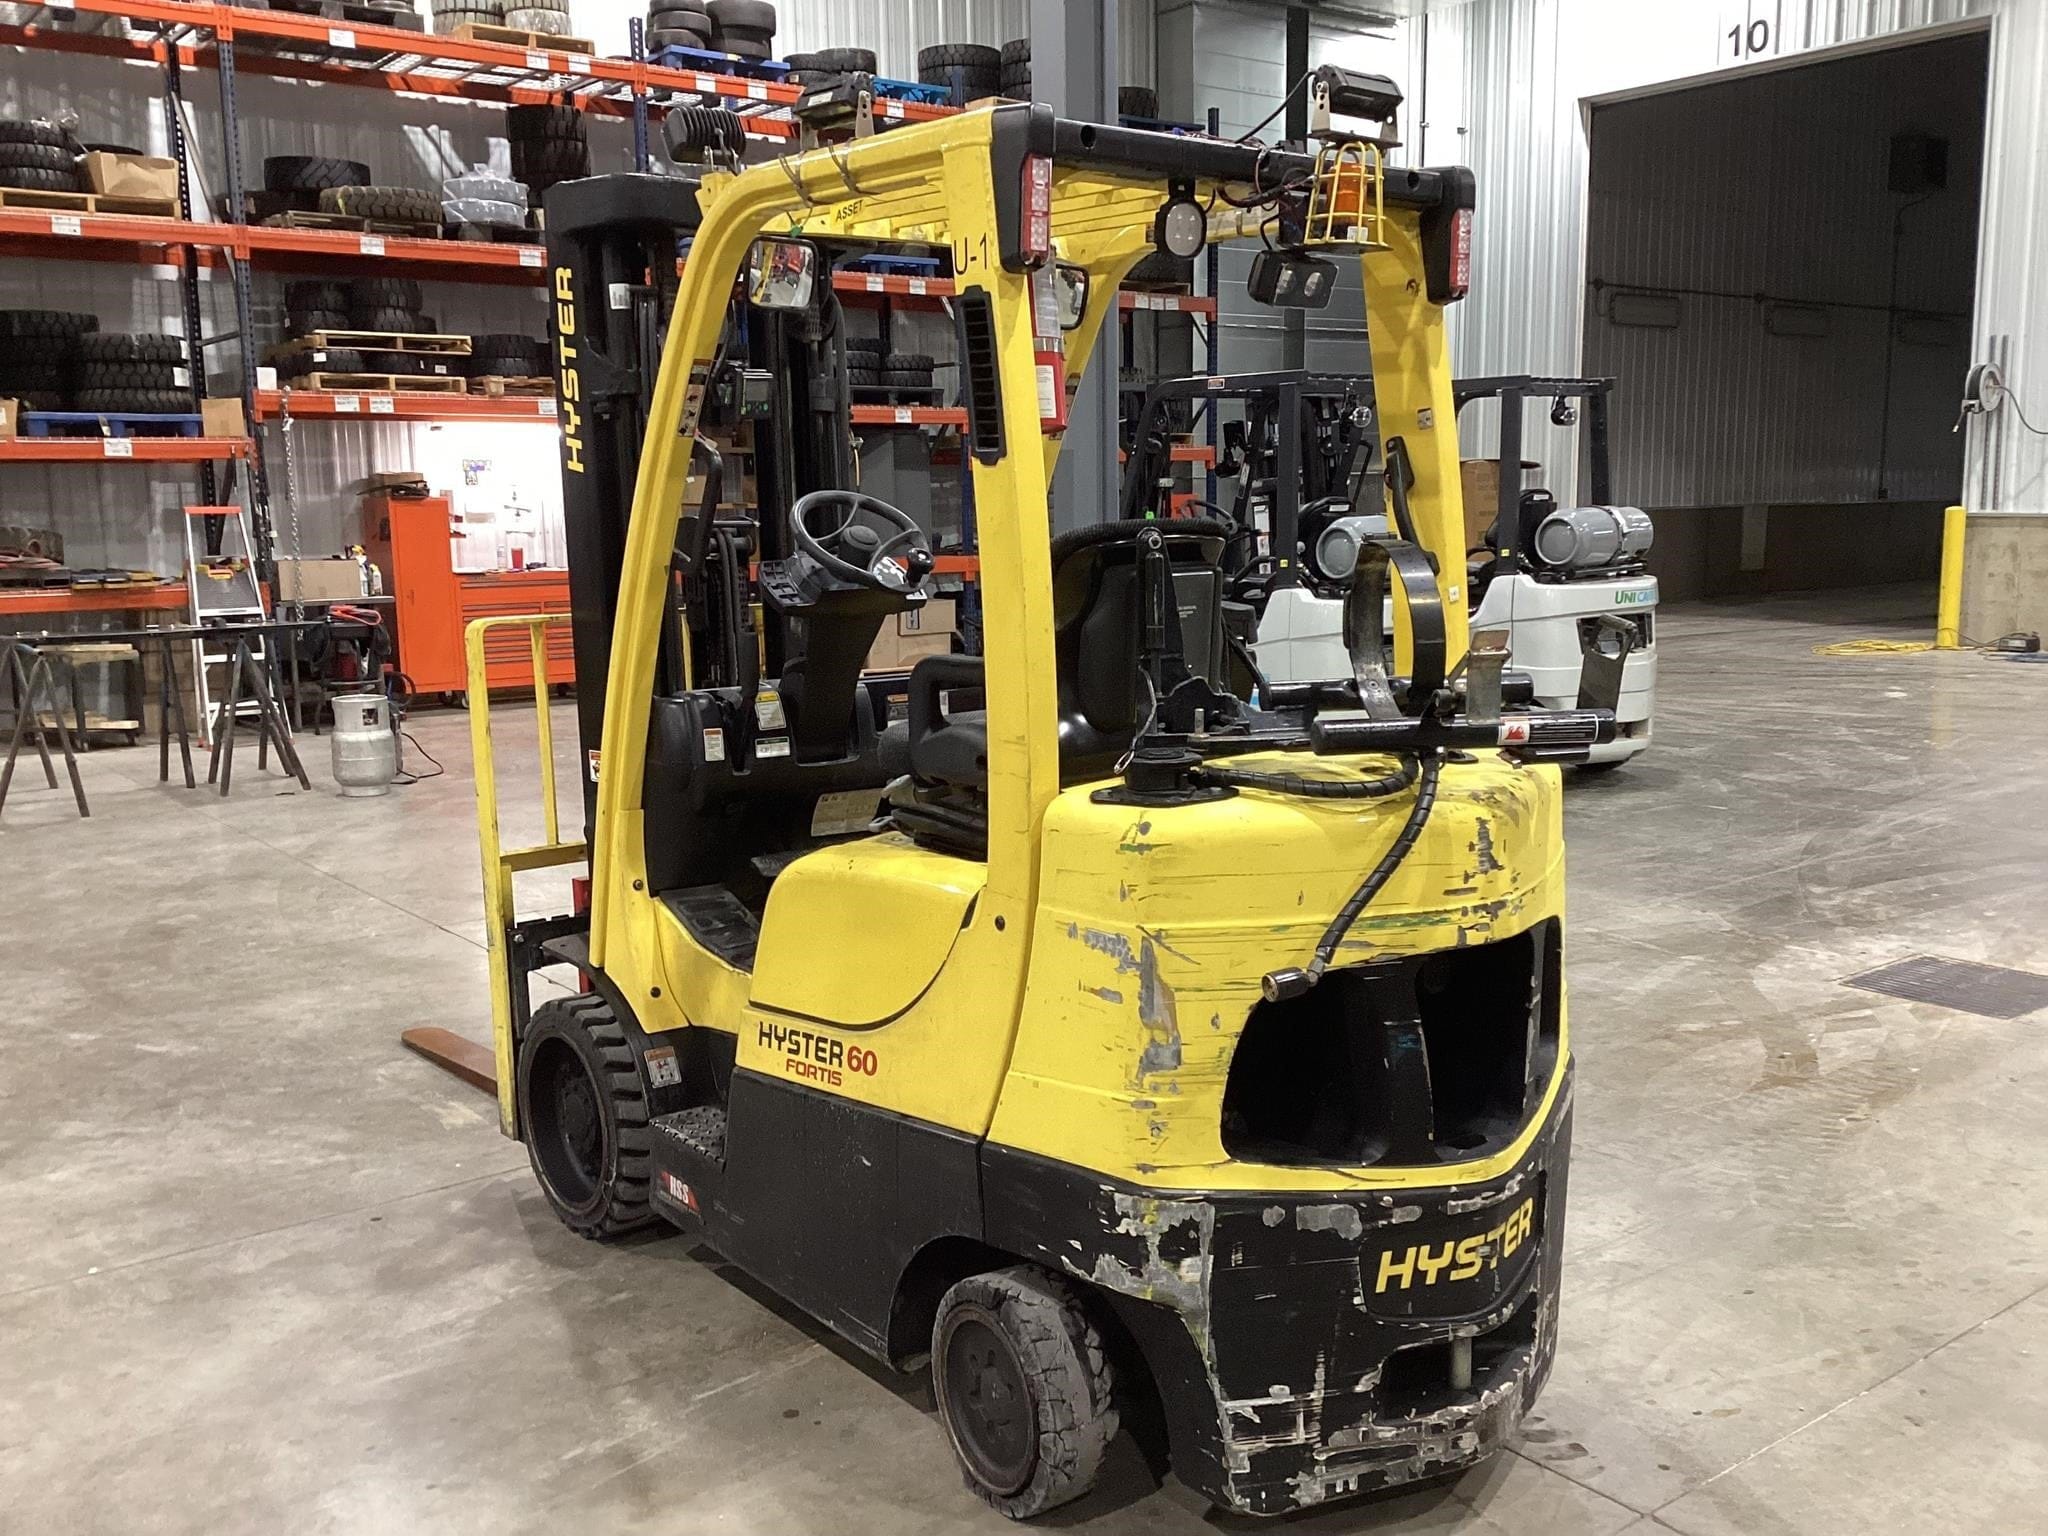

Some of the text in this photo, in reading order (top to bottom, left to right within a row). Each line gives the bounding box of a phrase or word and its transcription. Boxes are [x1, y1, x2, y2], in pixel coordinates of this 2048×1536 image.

[1728, 19, 1769, 57] 10
[835, 199, 864, 223] ASSET
[953, 231, 989, 275] U-1
[555, 266, 584, 473] HYSTER
[758, 1020, 878, 1076] HYSTER 60
[786, 1058, 842, 1087] FORTIS
[669, 1175, 689, 1204] HSS
[1375, 1197, 1533, 1293] HYSTER
